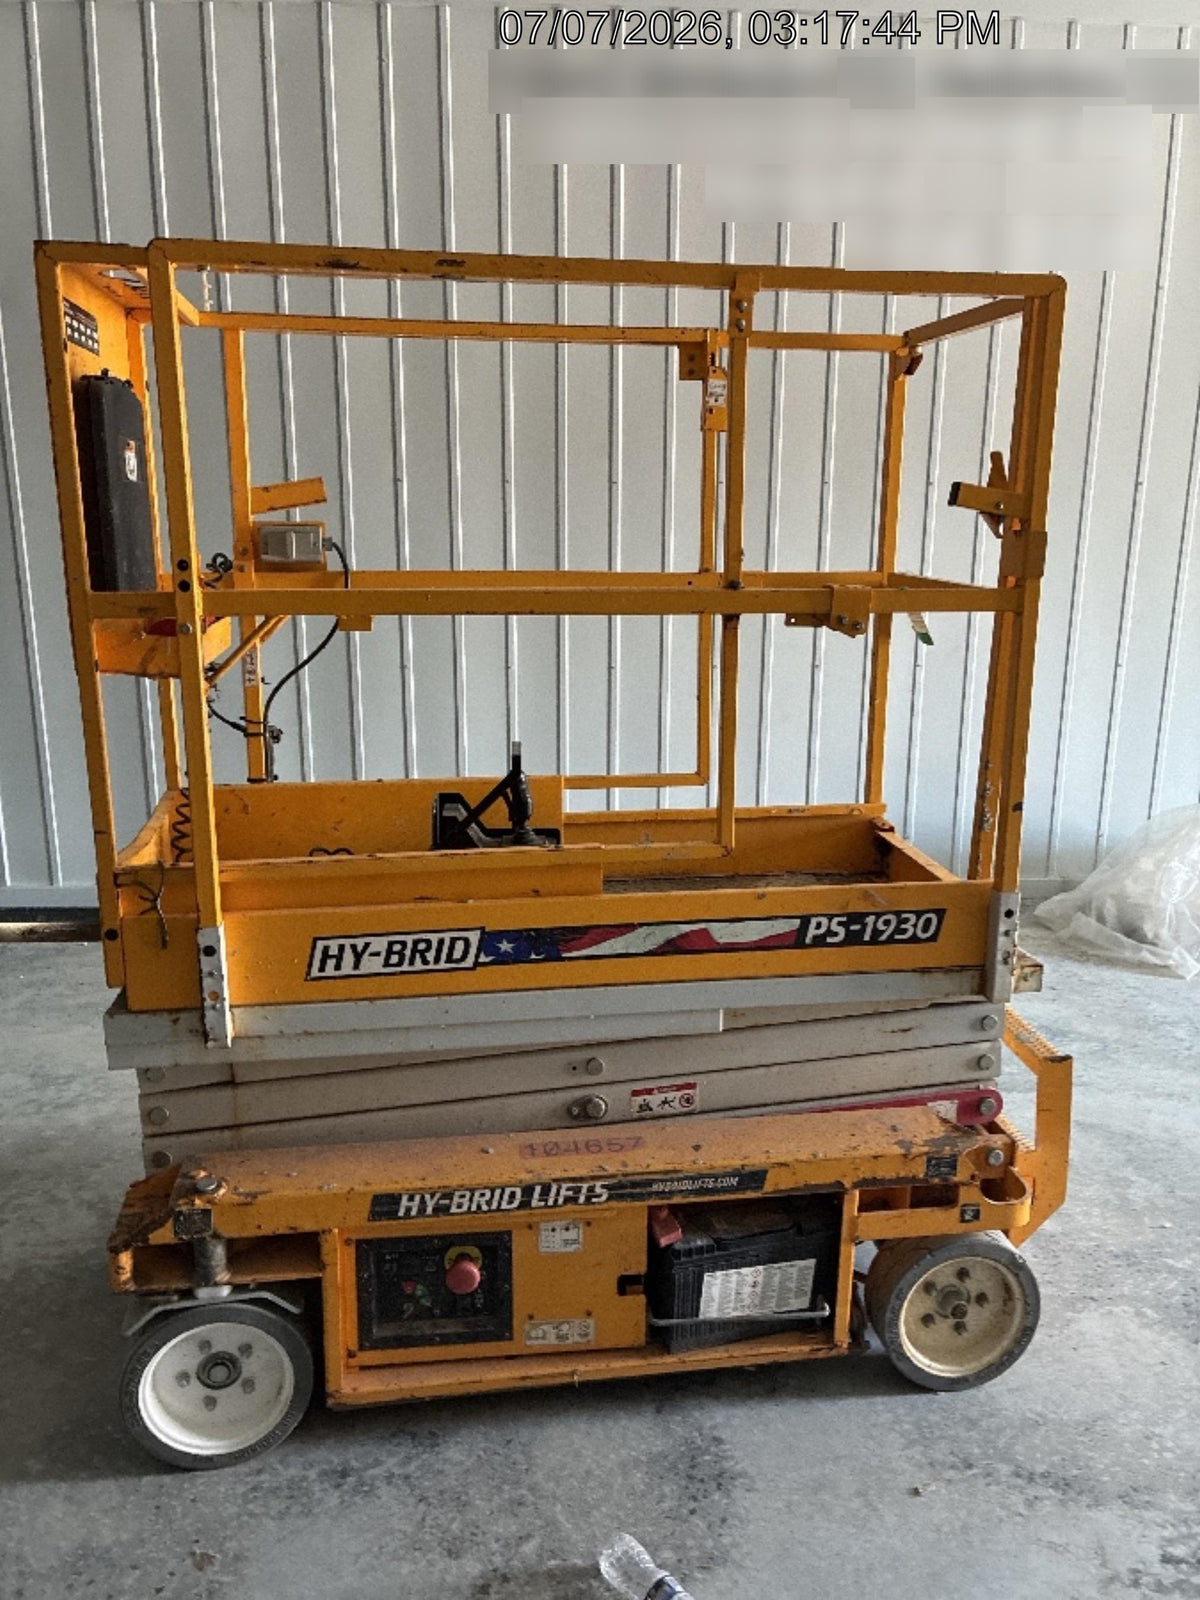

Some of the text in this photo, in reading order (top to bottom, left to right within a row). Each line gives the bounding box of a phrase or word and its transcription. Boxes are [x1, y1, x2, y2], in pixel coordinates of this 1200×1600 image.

[805, 912, 938, 945] PS-1930
[317, 936, 474, 973] HY-BRID
[397, 1181, 609, 1218] HY-BRID LIFTS
